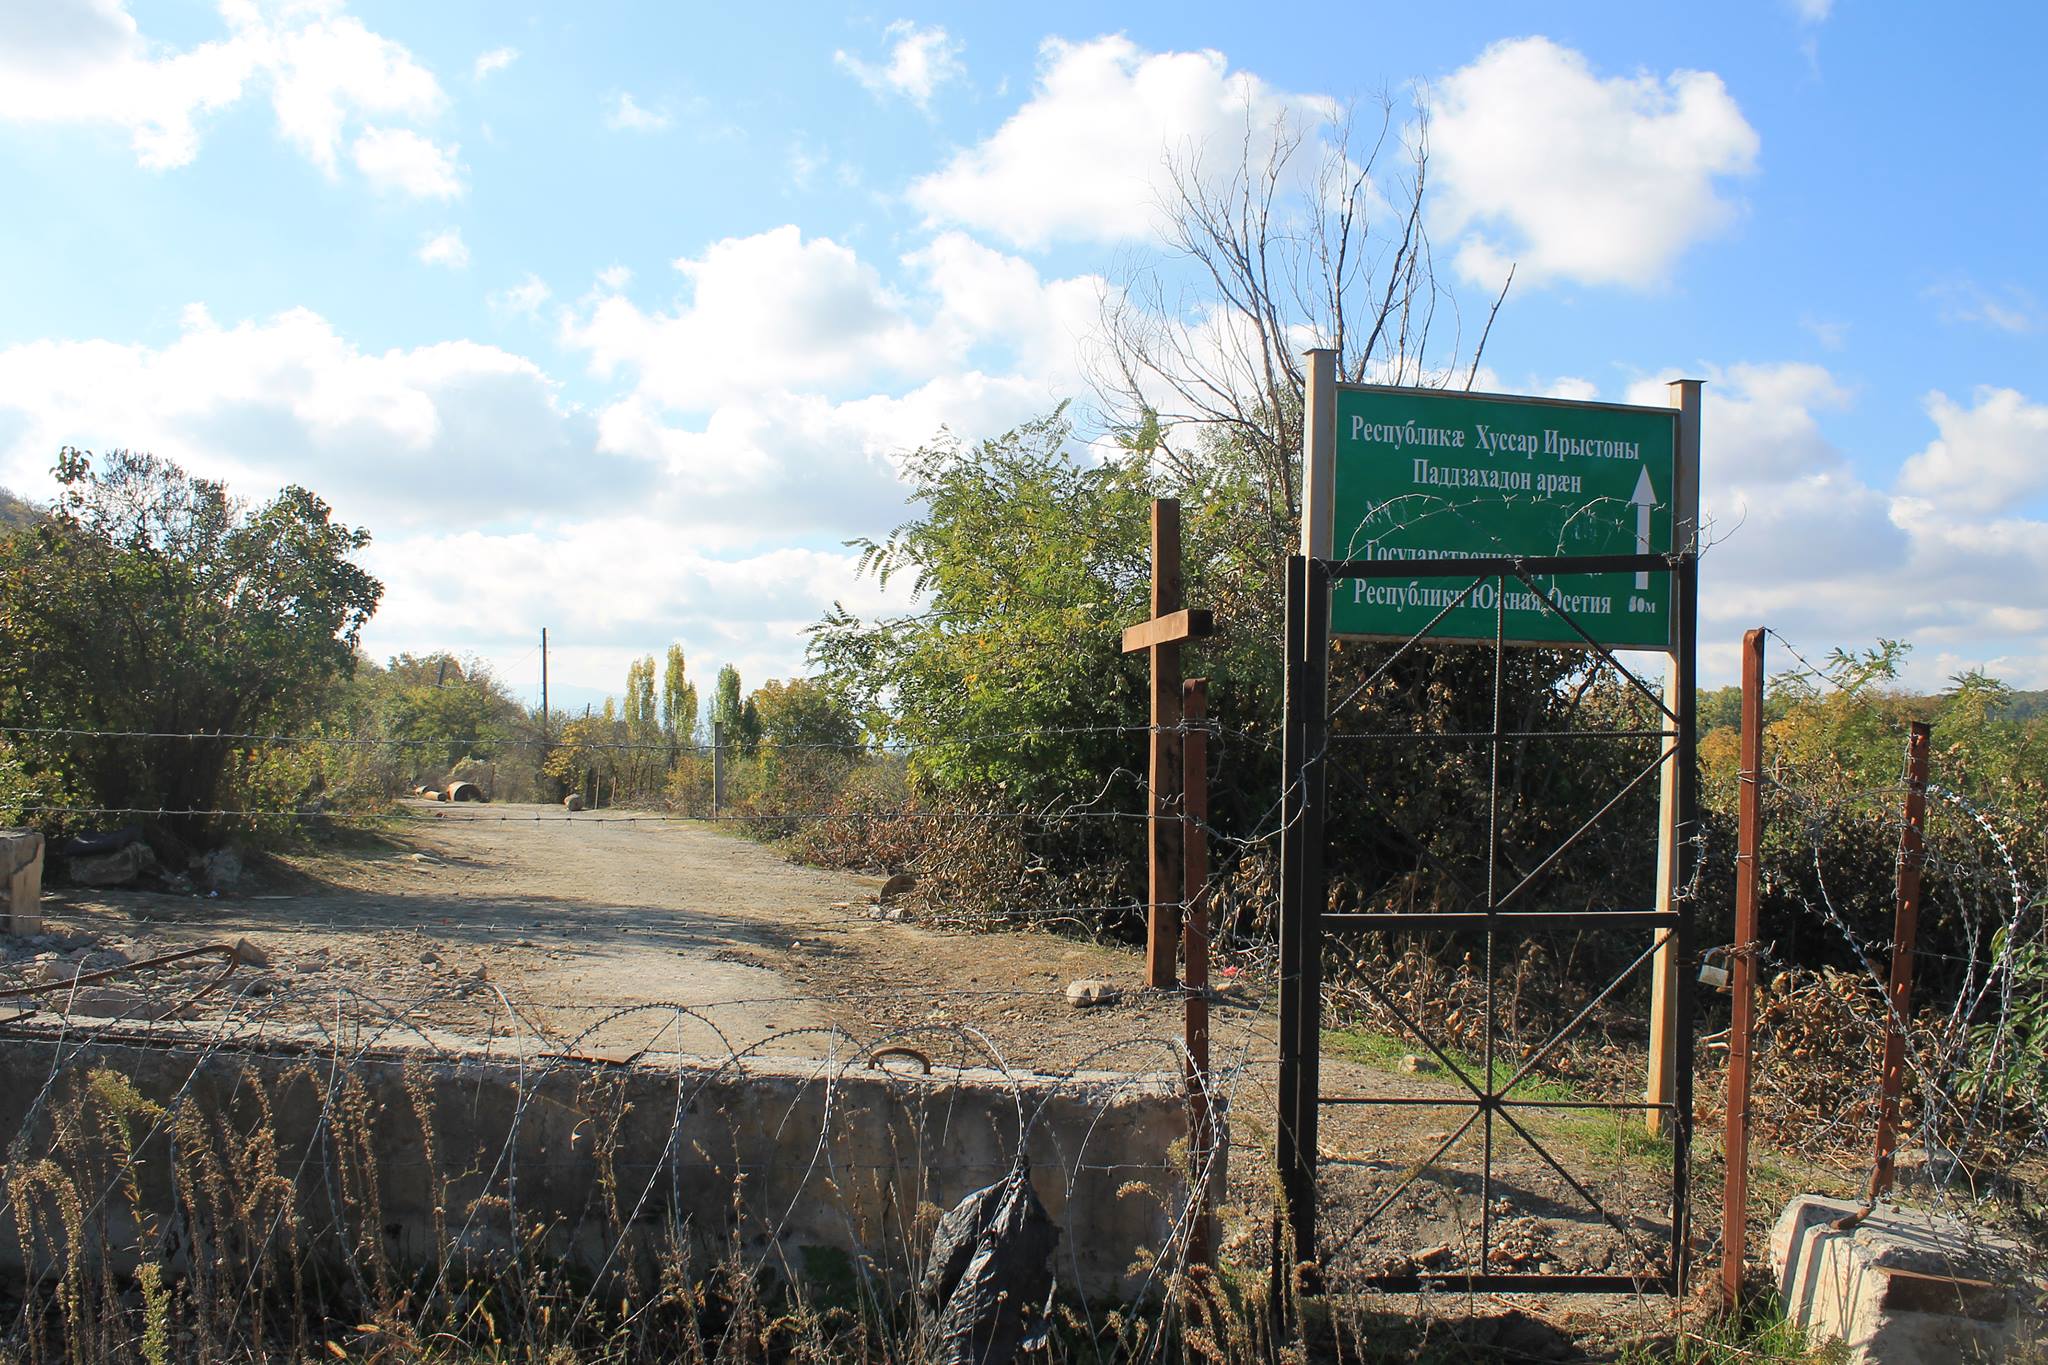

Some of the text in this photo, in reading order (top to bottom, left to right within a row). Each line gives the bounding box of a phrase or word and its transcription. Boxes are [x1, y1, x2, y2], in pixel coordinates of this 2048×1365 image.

[1351, 415, 1640, 462] Республикæ Хуссар Ирыстоны
[1412, 458, 1582, 499] Паддзахадон арæн
[1353, 578, 1465, 612] Республики
[1547, 586, 1611, 614] Осетия
